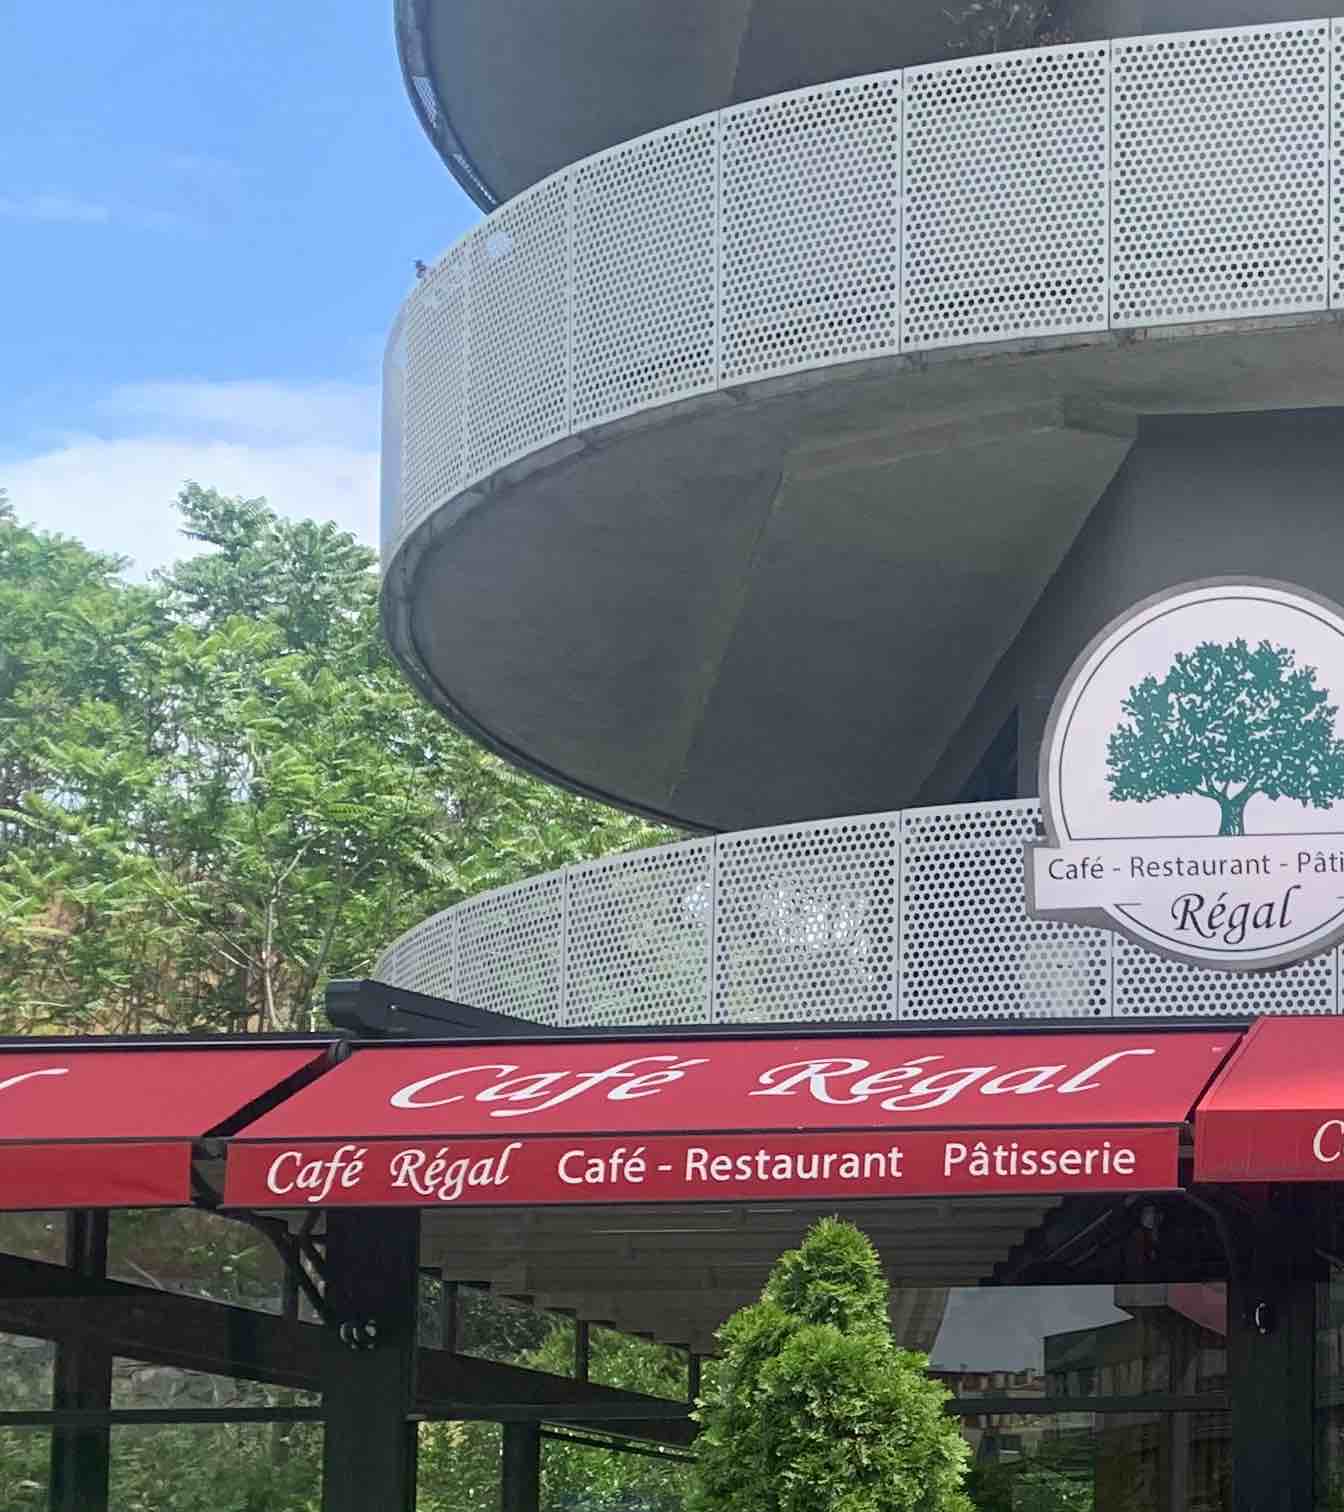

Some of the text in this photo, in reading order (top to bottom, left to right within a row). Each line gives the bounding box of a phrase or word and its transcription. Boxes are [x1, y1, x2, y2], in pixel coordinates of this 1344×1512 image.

[1047, 855, 1105, 881] Café
[1129, 855, 1272, 879] Restaurant
[1169, 884, 1303, 945] Régal
[390, 1048, 1156, 1118] Café Régal
[266, 1144, 367, 1203] Café
[389, 1142, 523, 1202] Régal
[558, 1147, 646, 1185] Café
[685, 1147, 904, 1182] Restaurant
[943, 1141, 1136, 1177] Pâtisserie
